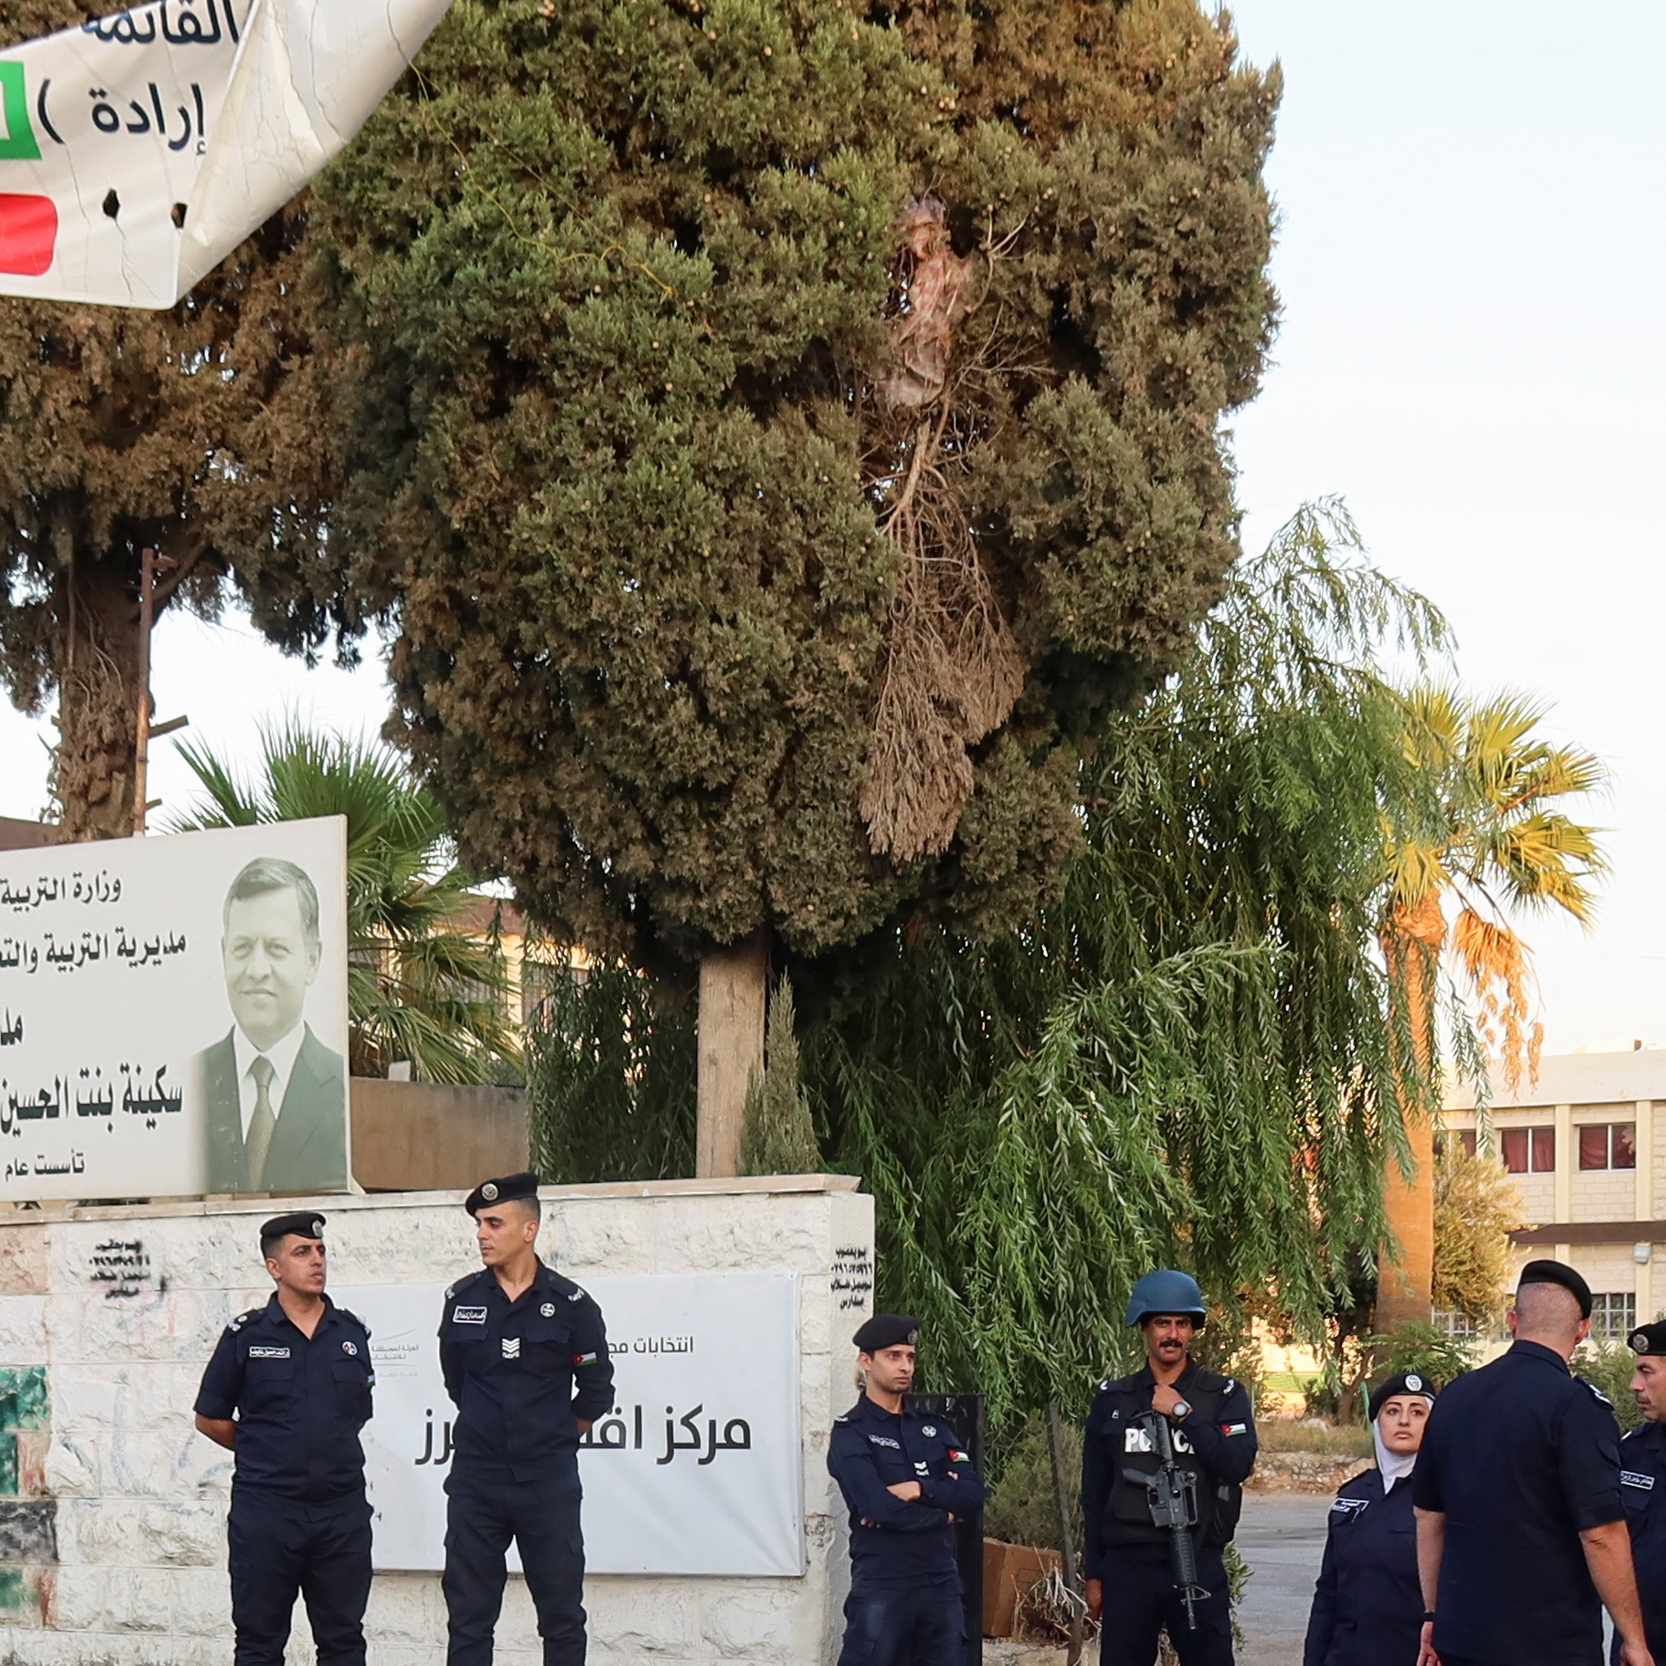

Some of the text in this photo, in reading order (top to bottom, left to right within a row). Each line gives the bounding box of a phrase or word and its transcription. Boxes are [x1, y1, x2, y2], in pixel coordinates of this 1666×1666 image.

[88, 82, 207, 155] إرادة
[0, 876, 66, 913] التربية
[72, 869, 122, 903] وزارة
[44, 932, 109, 973] التربية
[116, 926, 187, 968] مديرية
[0, 1073, 70, 1139] الحسين
[76, 1066, 115, 1134] بنت
[119, 1062, 184, 1130] سكينة
[5, 1157, 30, 1183] عام
[34, 1148, 86, 1176] تأسست
[633, 1335, 694, 1358] انتخابات
[656, 1403, 752, 1466] مركز
